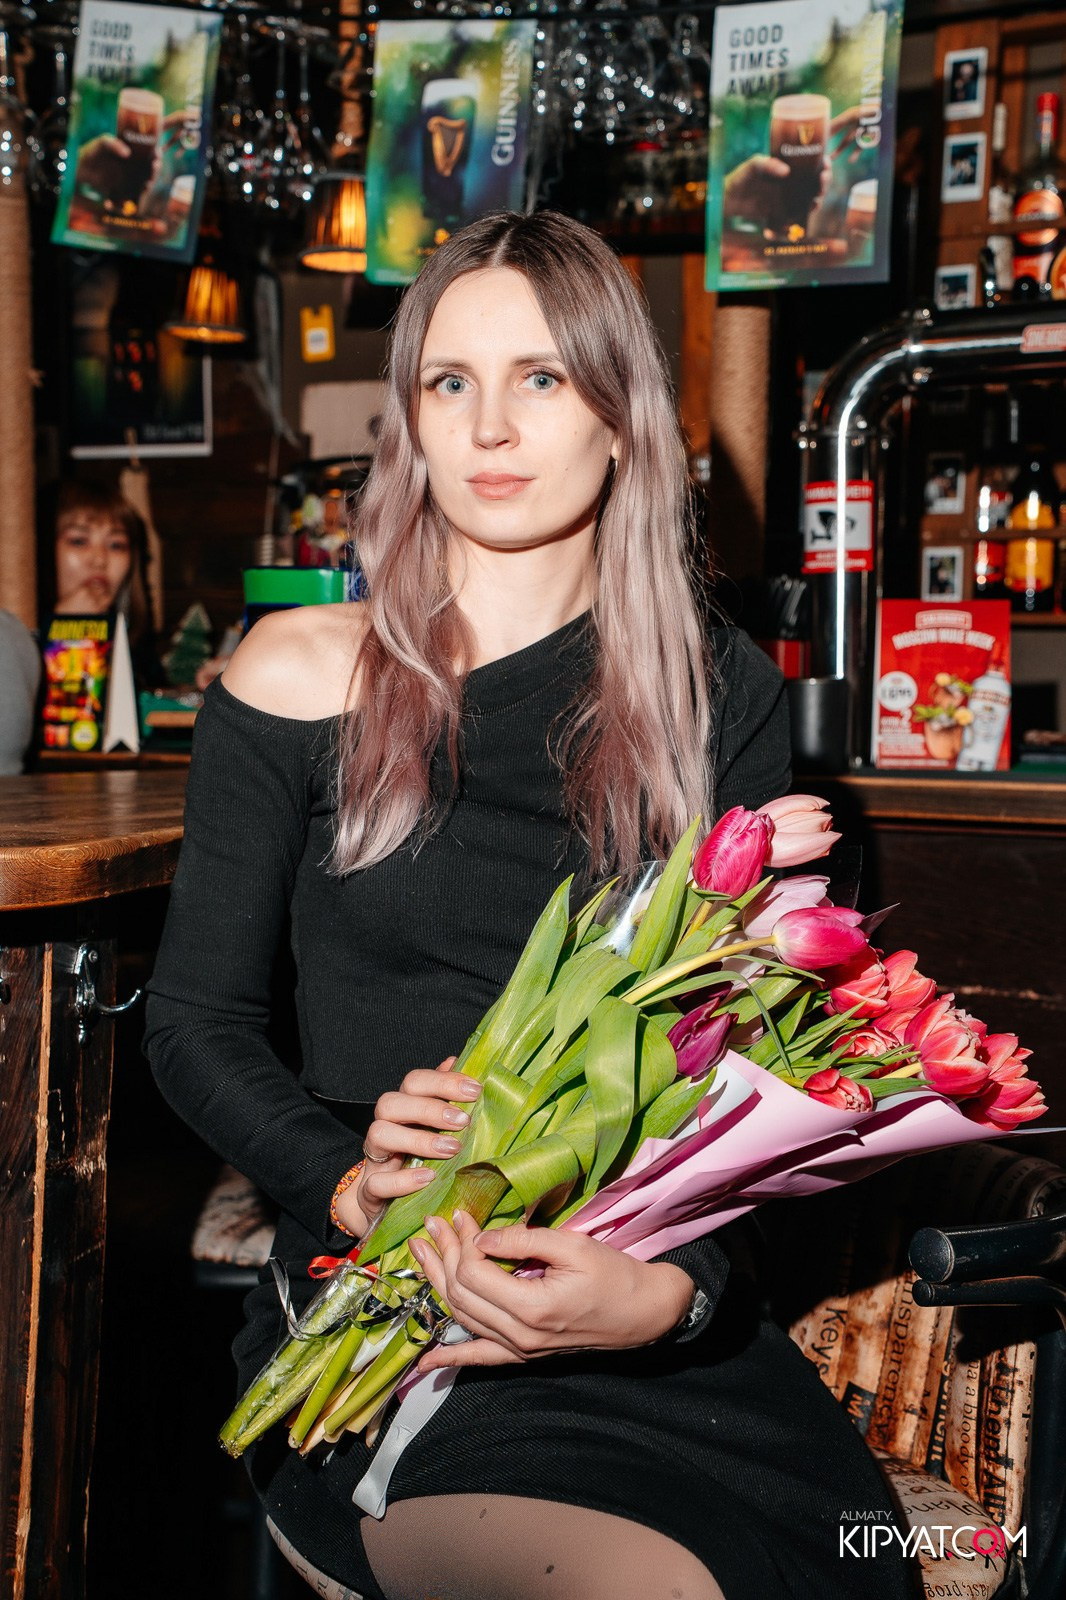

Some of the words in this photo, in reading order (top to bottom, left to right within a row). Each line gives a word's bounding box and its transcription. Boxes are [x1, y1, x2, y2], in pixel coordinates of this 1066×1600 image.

[729, 24, 784, 49] GOOD
[728, 49, 789, 72] TIMES
[727, 73, 787, 96] AWAIT
[491, 38, 522, 167] GUINNESS
[957, 1403, 978, 1470] bloody
